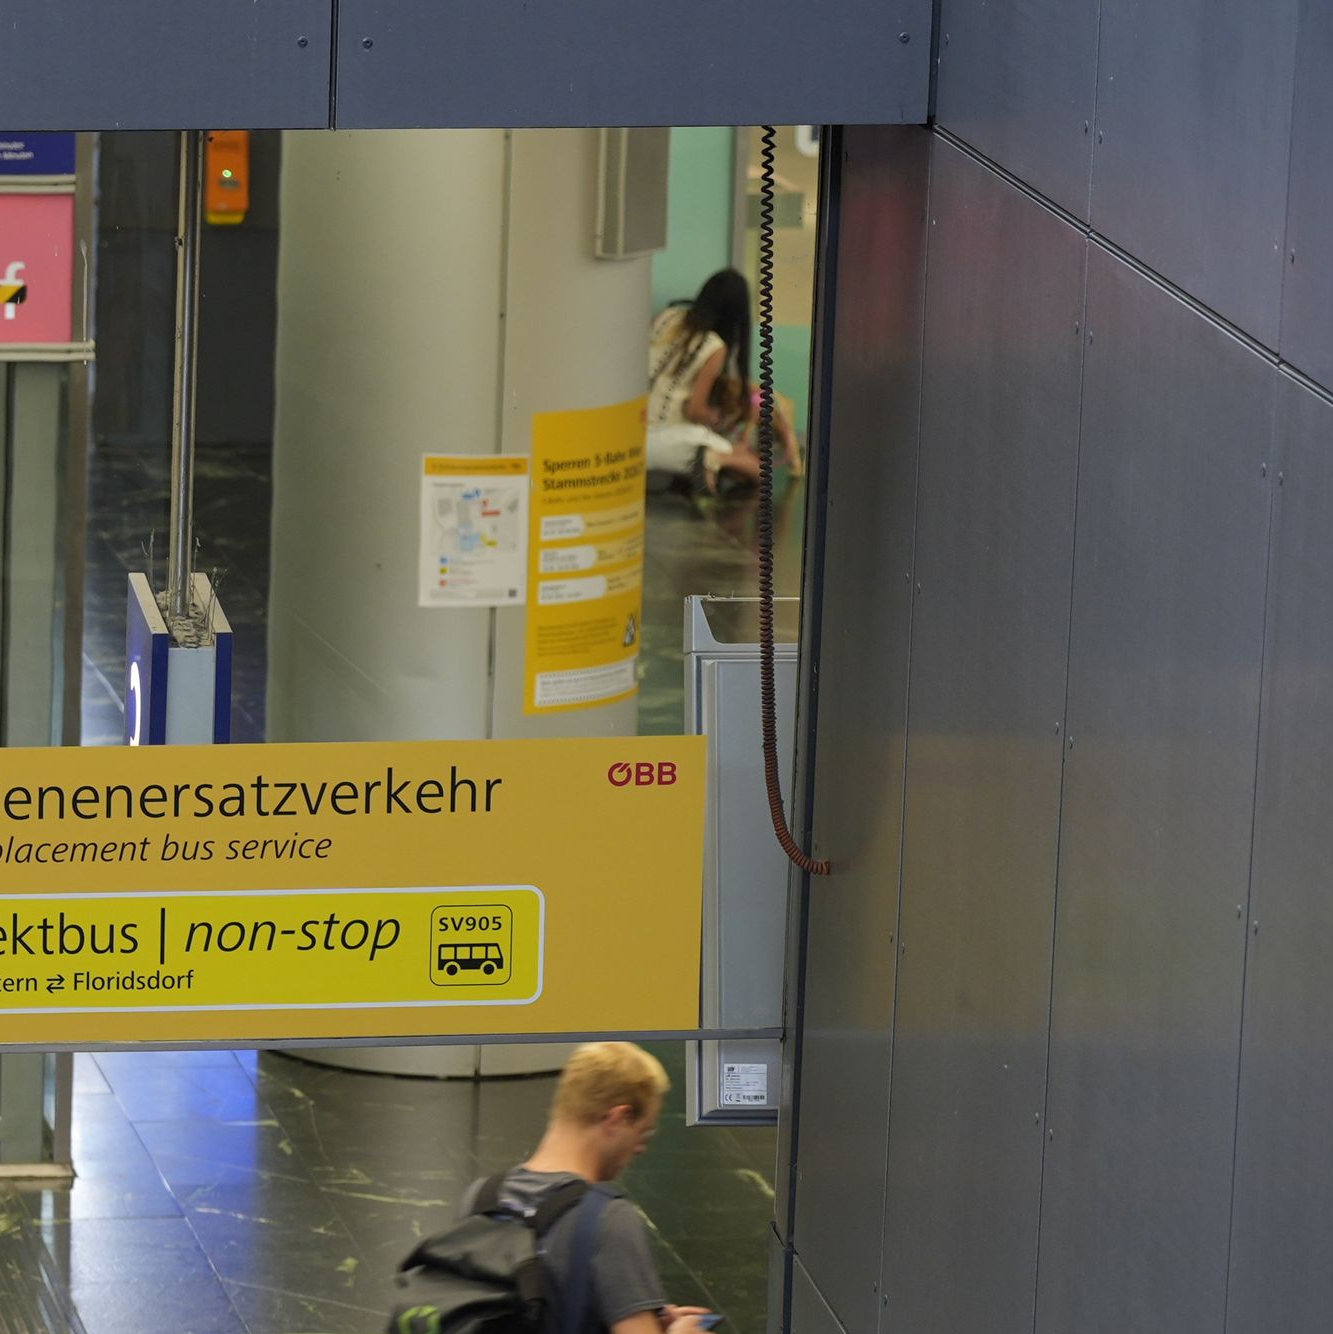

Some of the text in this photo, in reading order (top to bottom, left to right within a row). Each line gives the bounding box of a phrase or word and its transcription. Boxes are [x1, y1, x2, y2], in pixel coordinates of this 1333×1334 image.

[608, 762, 677, 787] ÖBB
[161, 833, 214, 862] bus
[226, 834, 332, 861] service
[439, 917, 502, 932] SV905
[185, 913, 401, 962] non-stop
[74, 970, 195, 991] Floridsdorf
